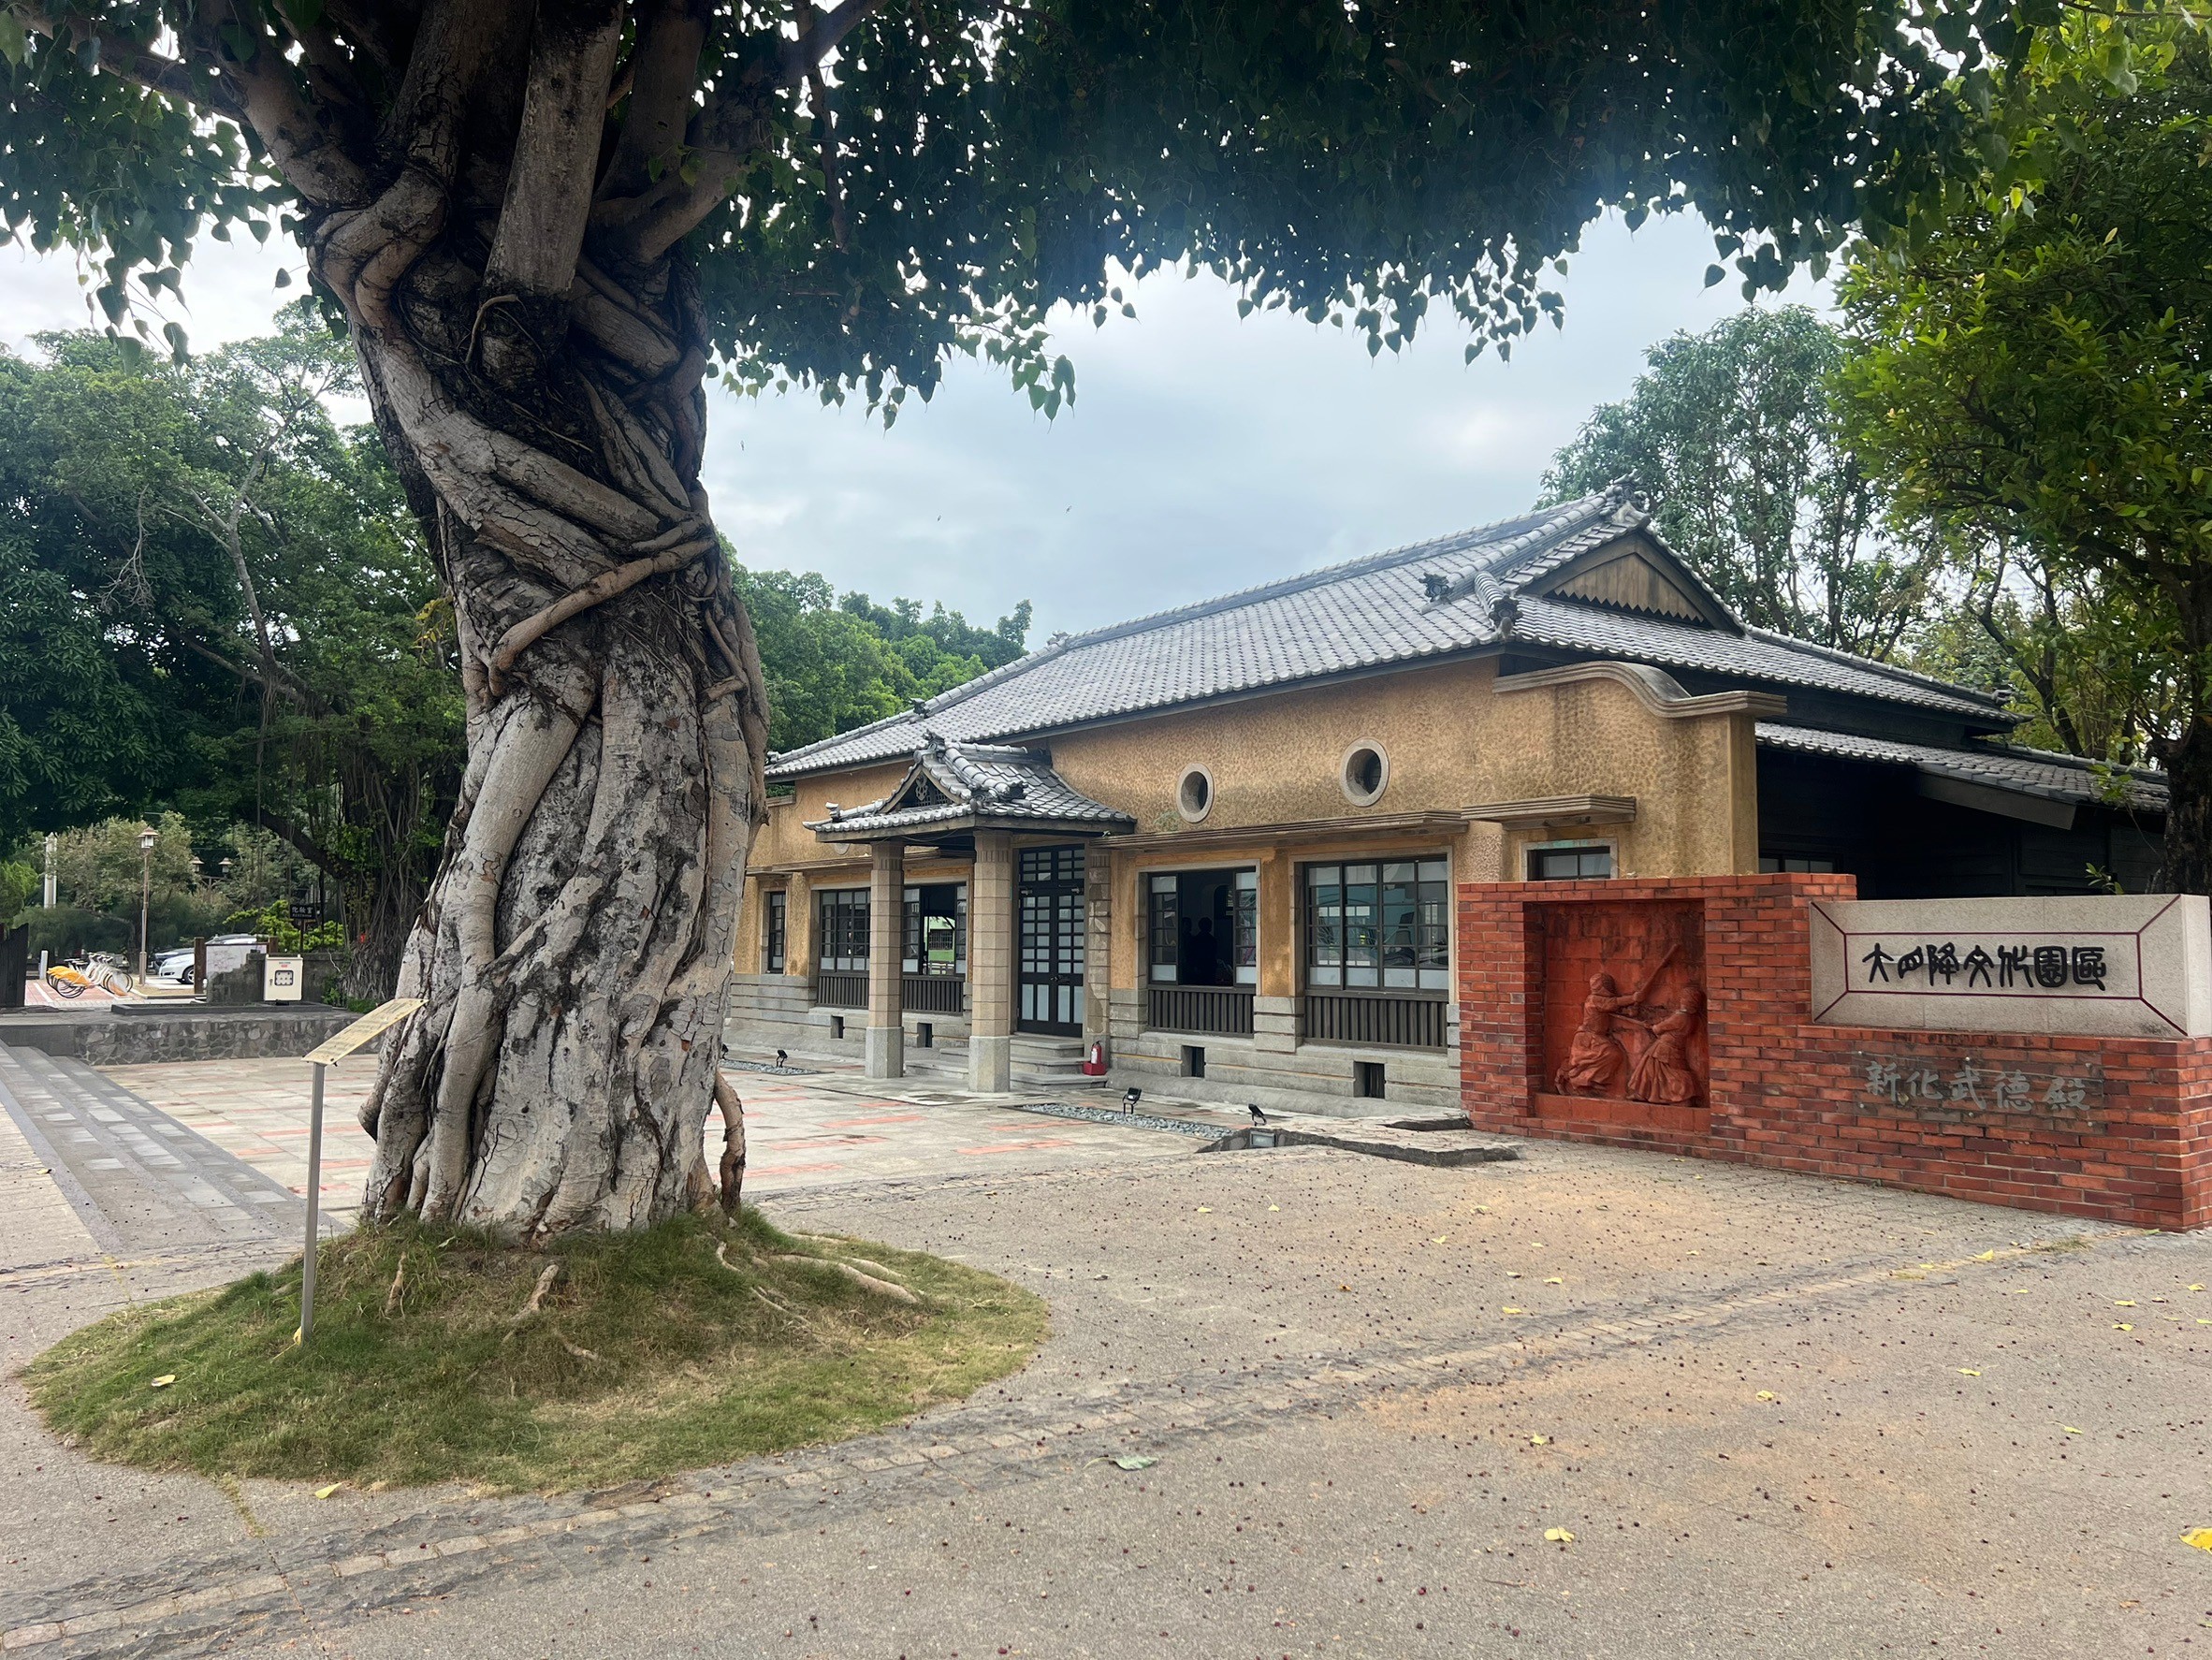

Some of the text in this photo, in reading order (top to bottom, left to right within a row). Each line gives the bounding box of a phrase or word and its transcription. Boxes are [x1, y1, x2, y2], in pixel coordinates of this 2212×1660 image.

[1865, 1060, 2091, 1111] 新化武德殿
